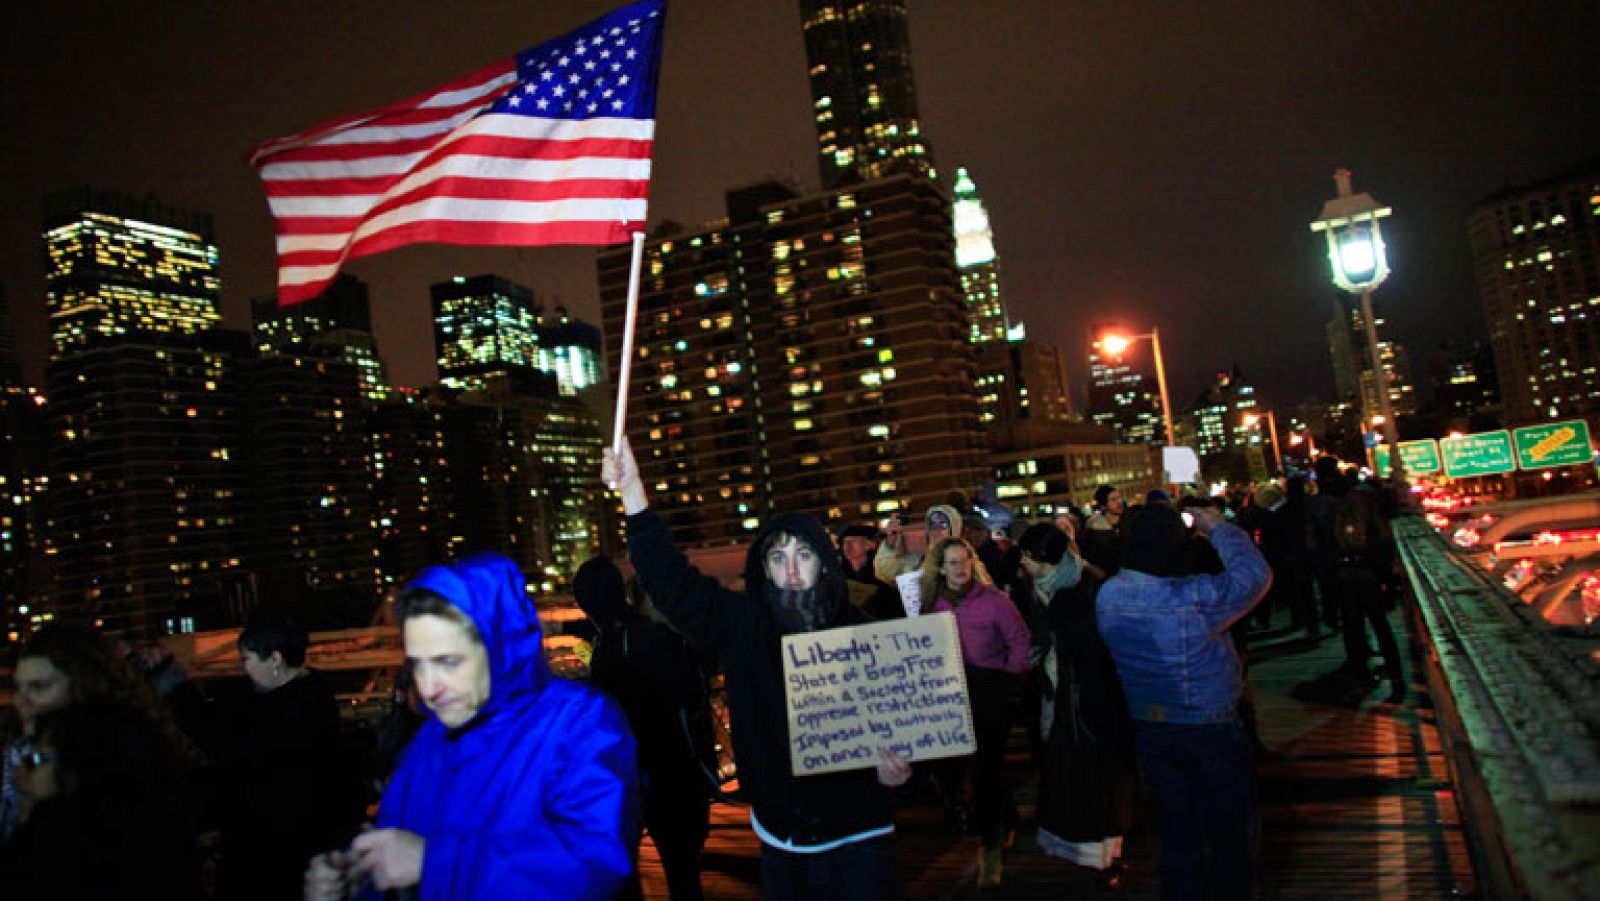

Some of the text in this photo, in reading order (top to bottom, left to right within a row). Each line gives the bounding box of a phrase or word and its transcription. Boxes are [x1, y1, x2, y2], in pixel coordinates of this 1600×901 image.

[887, 632, 933, 651] The
[789, 672, 837, 692] State
[843, 667, 858, 682] of
[868, 720, 893, 739] by
[803, 753, 828, 769] on
[916, 733, 936, 748] of
